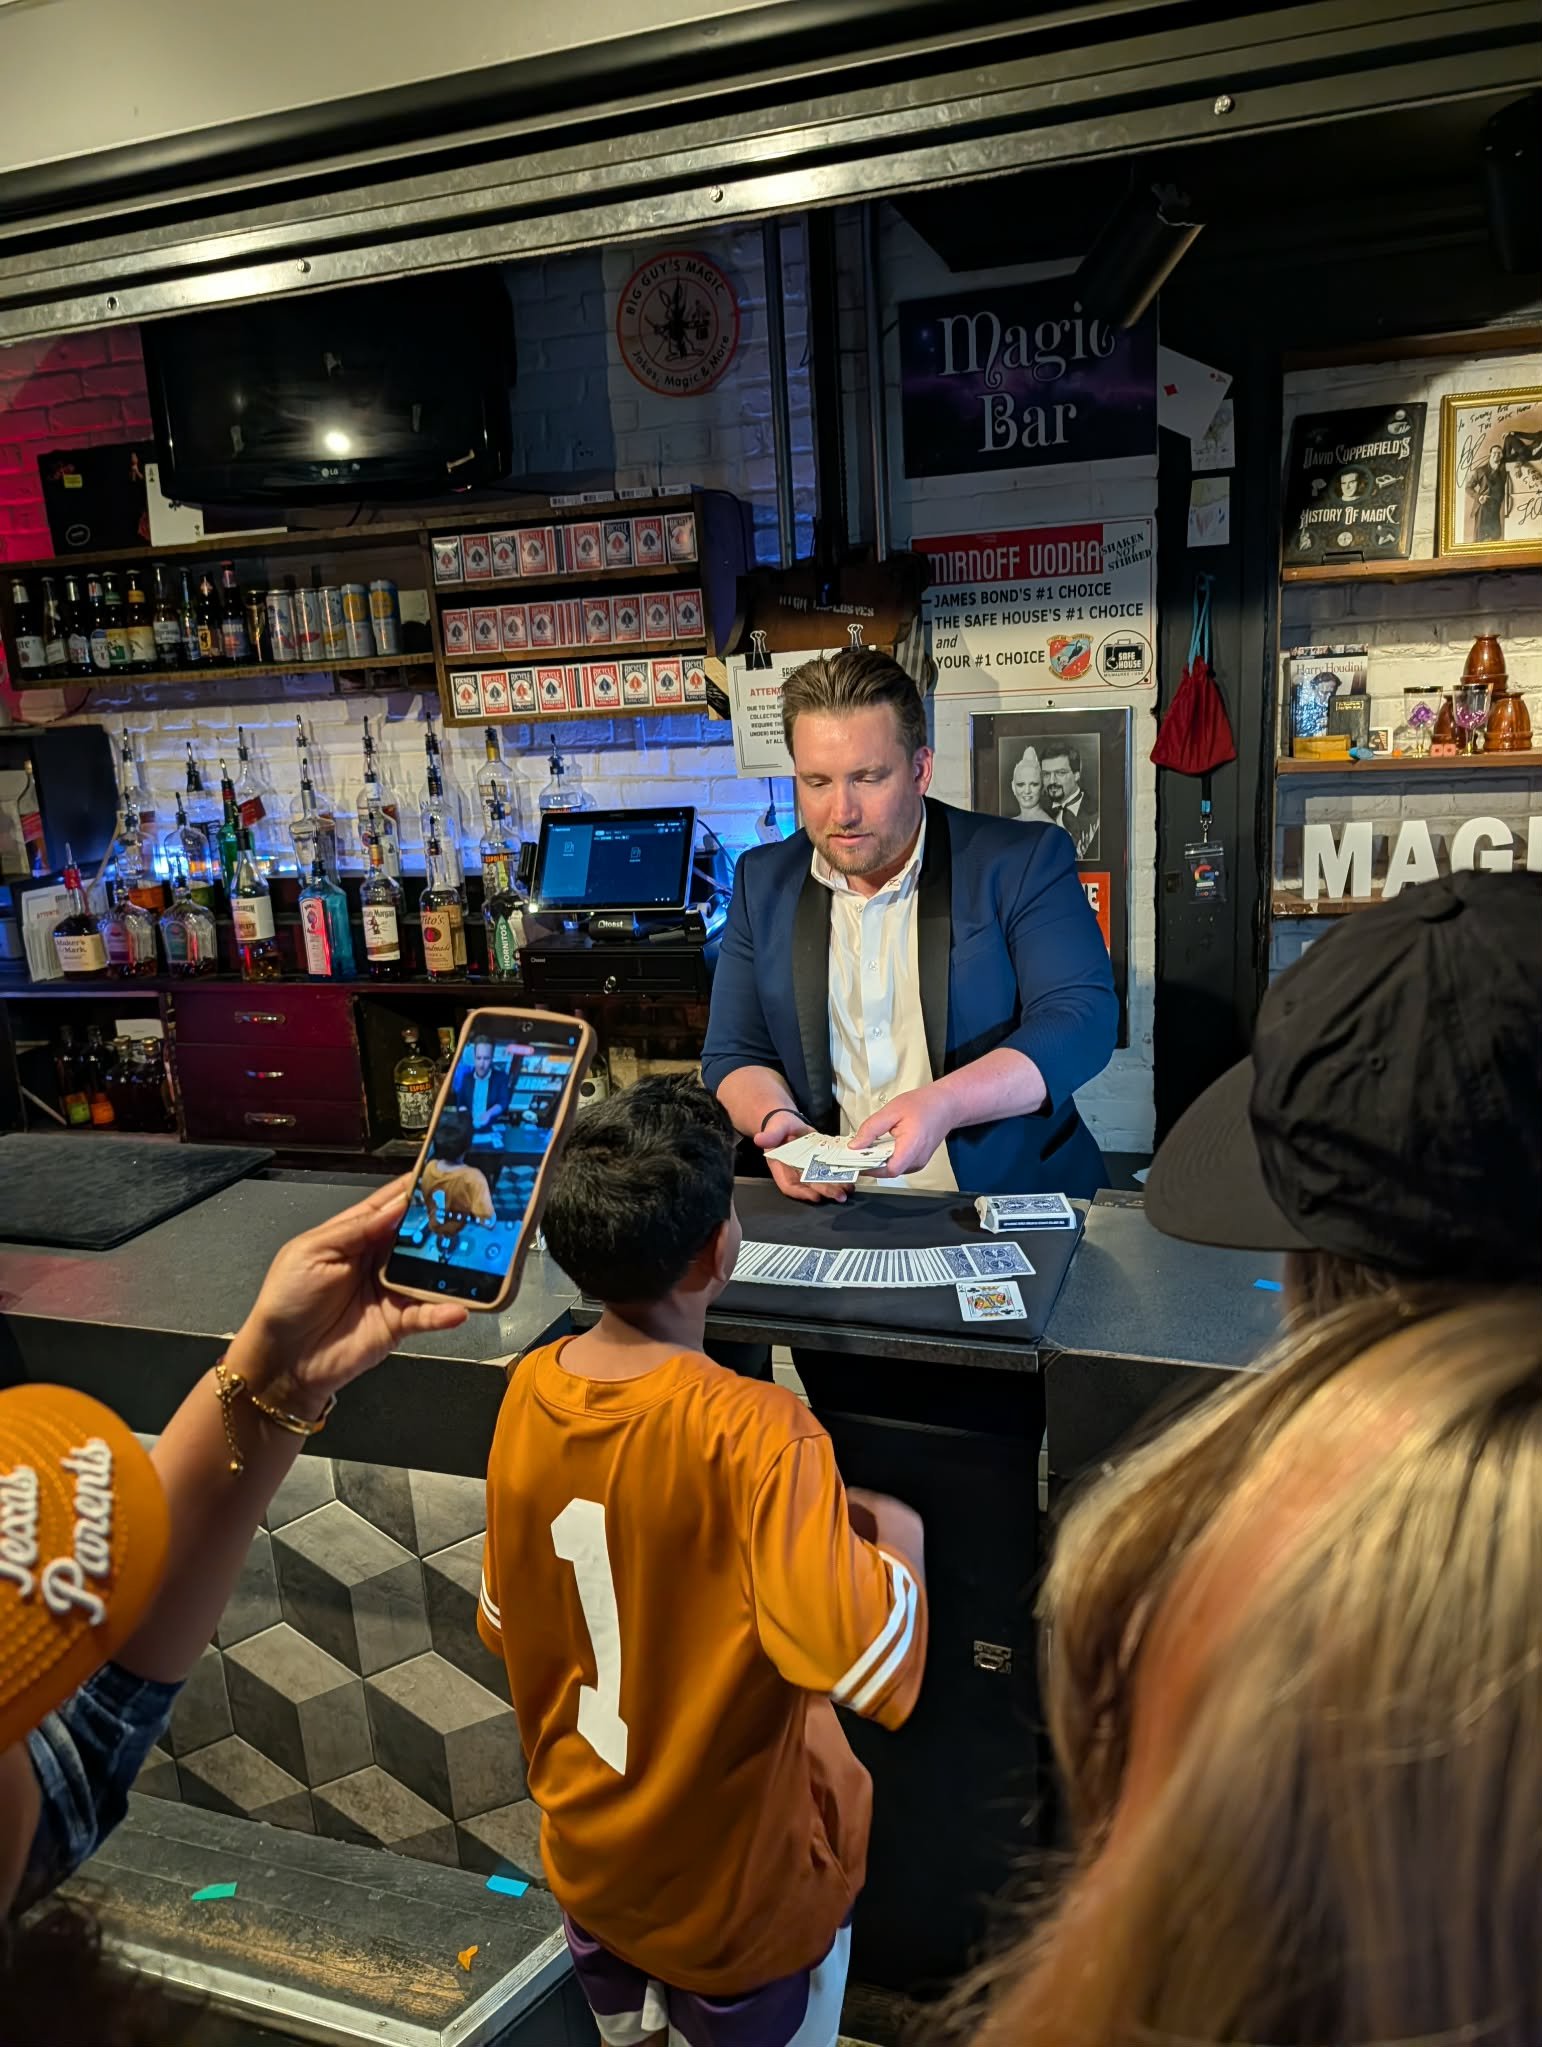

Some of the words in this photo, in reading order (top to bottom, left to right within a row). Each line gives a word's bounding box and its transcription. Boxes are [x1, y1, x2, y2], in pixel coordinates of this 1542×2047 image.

[626, 289, 642, 316] BIG
[641, 259, 681, 287] GUY'S
[685, 261, 726, 296] MAGIC
[936, 301, 1116, 388] Magic
[664, 374, 699, 389] Magic
[701, 366, 709, 378] &
[710, 335, 729, 369] More
[977, 392, 1077, 452] Bar
[1303, 447, 1333, 469] DAVID
[1335, 437, 1411, 464] COPPERFIELD'S
[1299, 508, 1342, 530] HISTORY
[1345, 506, 1359, 525] OF
[1361, 504, 1400, 524] MAGIC
[1100, 532, 1144, 556] SHAKEN
[1116, 544, 1136, 557] NOT
[927, 546, 1020, 584] MIRNOFF
[1107, 548, 1152, 572] STIRRED
[934, 592, 977, 608] JAMES
[980, 588, 1031, 604] BOND'S
[1036, 586, 1054, 601] #1
[1059, 582, 1112, 599] CHOICE
[935, 616, 960, 630] THE
[964, 613, 997, 628] SAFE
[1002, 608, 1061, 625] HOUSE'S
[1066, 607, 1084, 621] #1
[1089, 603, 1144, 620] CHOICE
[936, 634, 958, 649] and
[936, 656, 970, 670] YOUR
[975, 654, 991, 667] #1
[996, 650, 1045, 666] CHOICE
[1118, 651, 1135, 660] SAFE
[1118, 659, 1141, 669] HOUSE
[1296, 664, 1323, 675] Harry
[1325, 661, 1363, 673] Houdini
[510, 672, 531, 682] BICYCLE
[540, 671, 560, 681] BICYCLE
[592, 667, 615, 678] BICYCLE
[624, 663, 647, 675] BICYCLE
[500, 923, 511, 967] HORNITOS
[41, 1437, 114, 1626] Parents
[551, 1498, 628, 1776] 1
